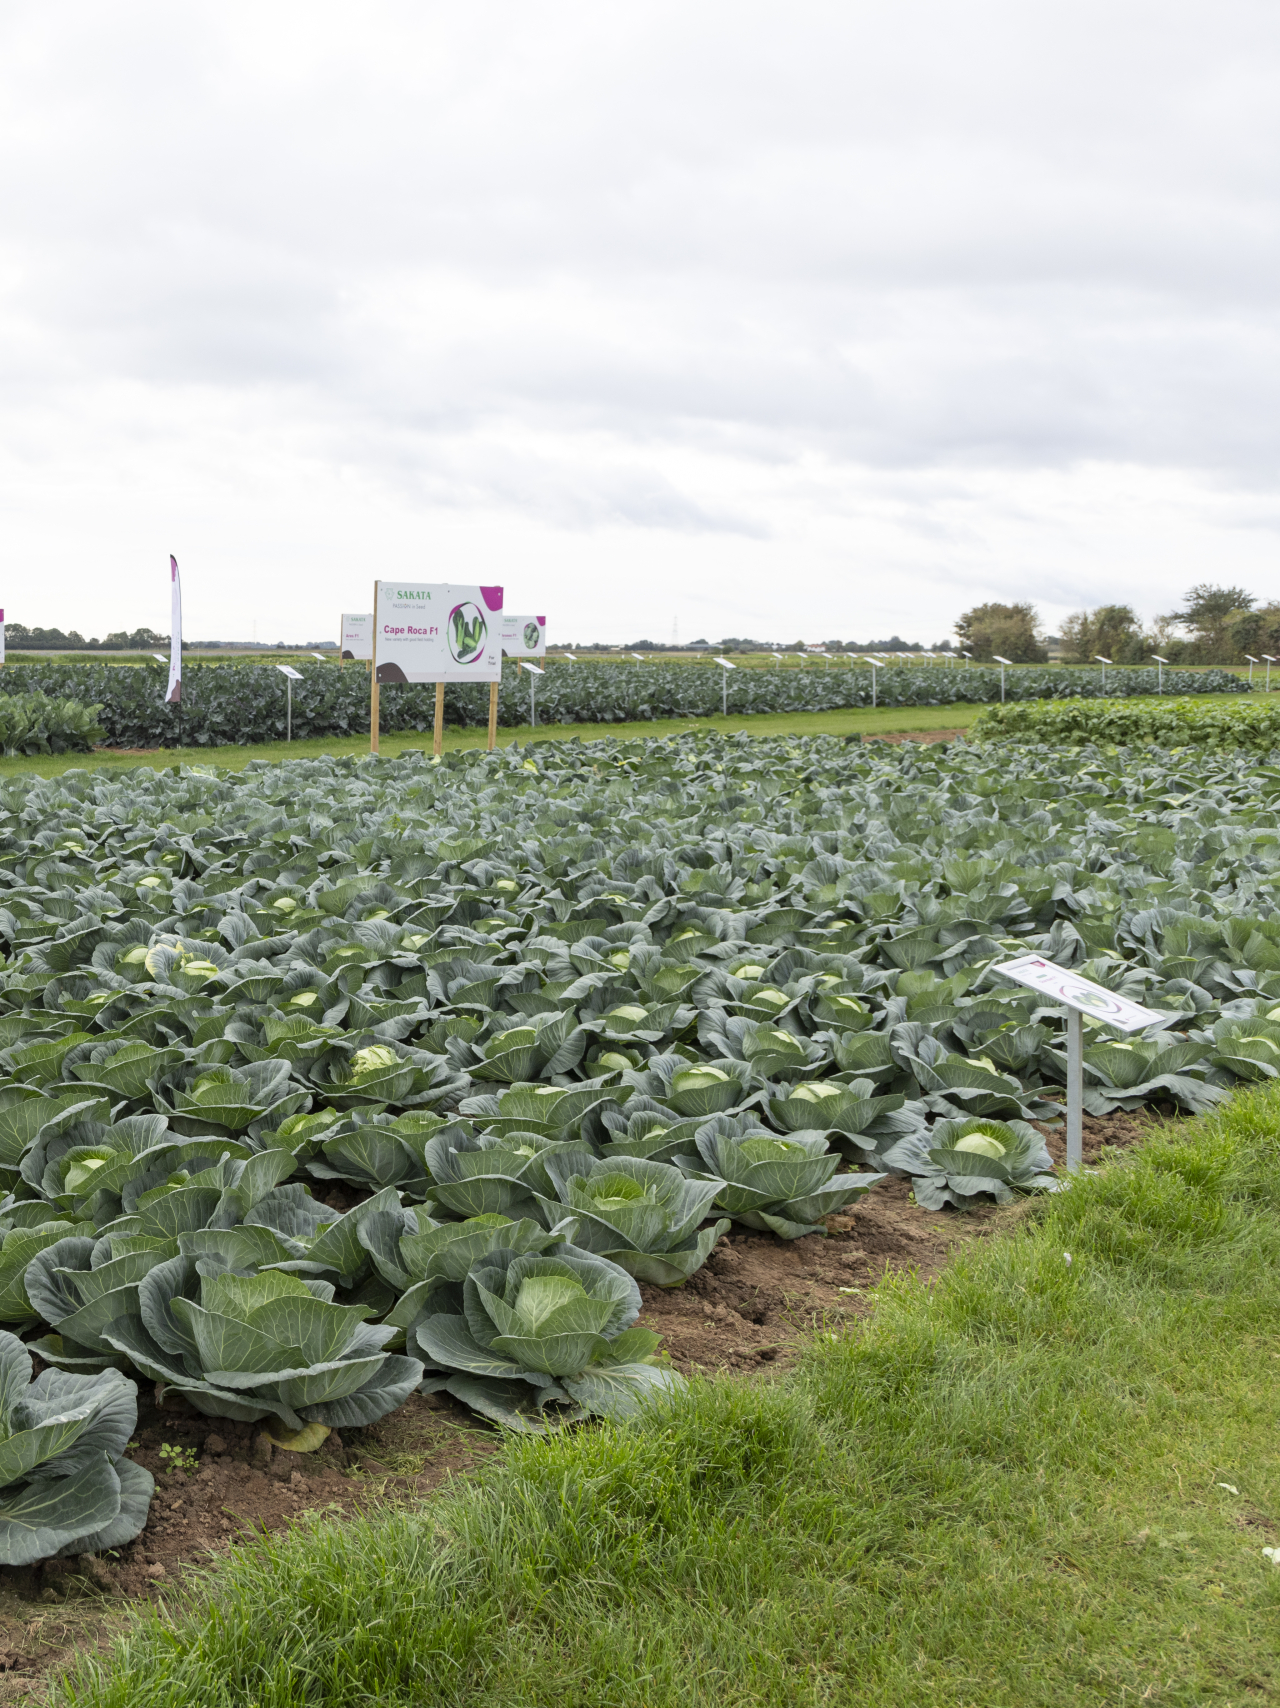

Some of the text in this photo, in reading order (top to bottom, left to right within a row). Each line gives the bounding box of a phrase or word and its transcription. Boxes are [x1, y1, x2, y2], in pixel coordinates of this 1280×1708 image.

[397, 590, 431, 600] SAKATA
[384, 625, 438, 636] Cape Roca F1
